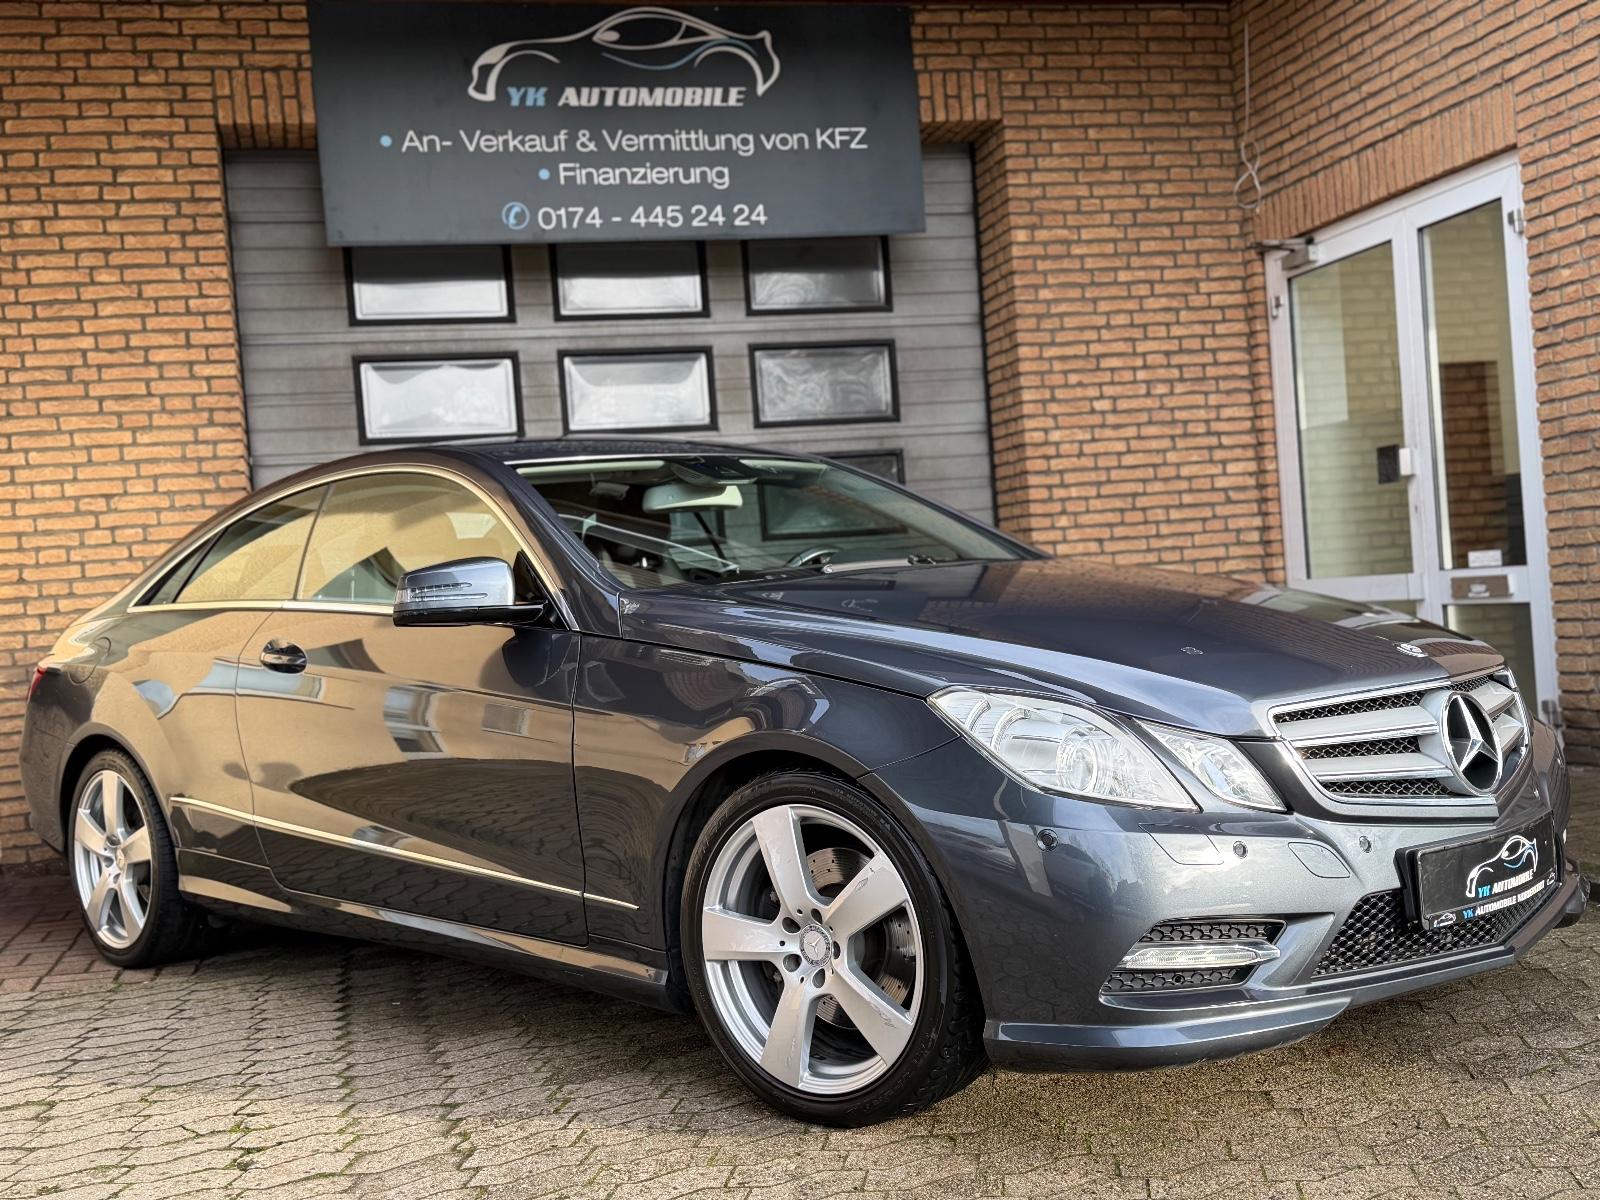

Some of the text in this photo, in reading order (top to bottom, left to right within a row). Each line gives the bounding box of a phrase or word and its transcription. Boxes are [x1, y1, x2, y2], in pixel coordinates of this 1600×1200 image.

[506, 86, 747, 107] YK AUTOMOBILE
[401, 127, 869, 157] An- Verkauf & Vermittlung von KFZ
[558, 162, 731, 190] Finanzierung
[537, 206, 604, 230] 0174
[630, 205, 684, 228] 445
[690, 204, 727, 227] 24
[732, 203, 768, 227] 24
[1477, 885, 1491, 898] YK
[1491, 868, 1534, 895] AUTOMOBILE
[1462, 895, 1517, 919] YK AUTOMOBILE
